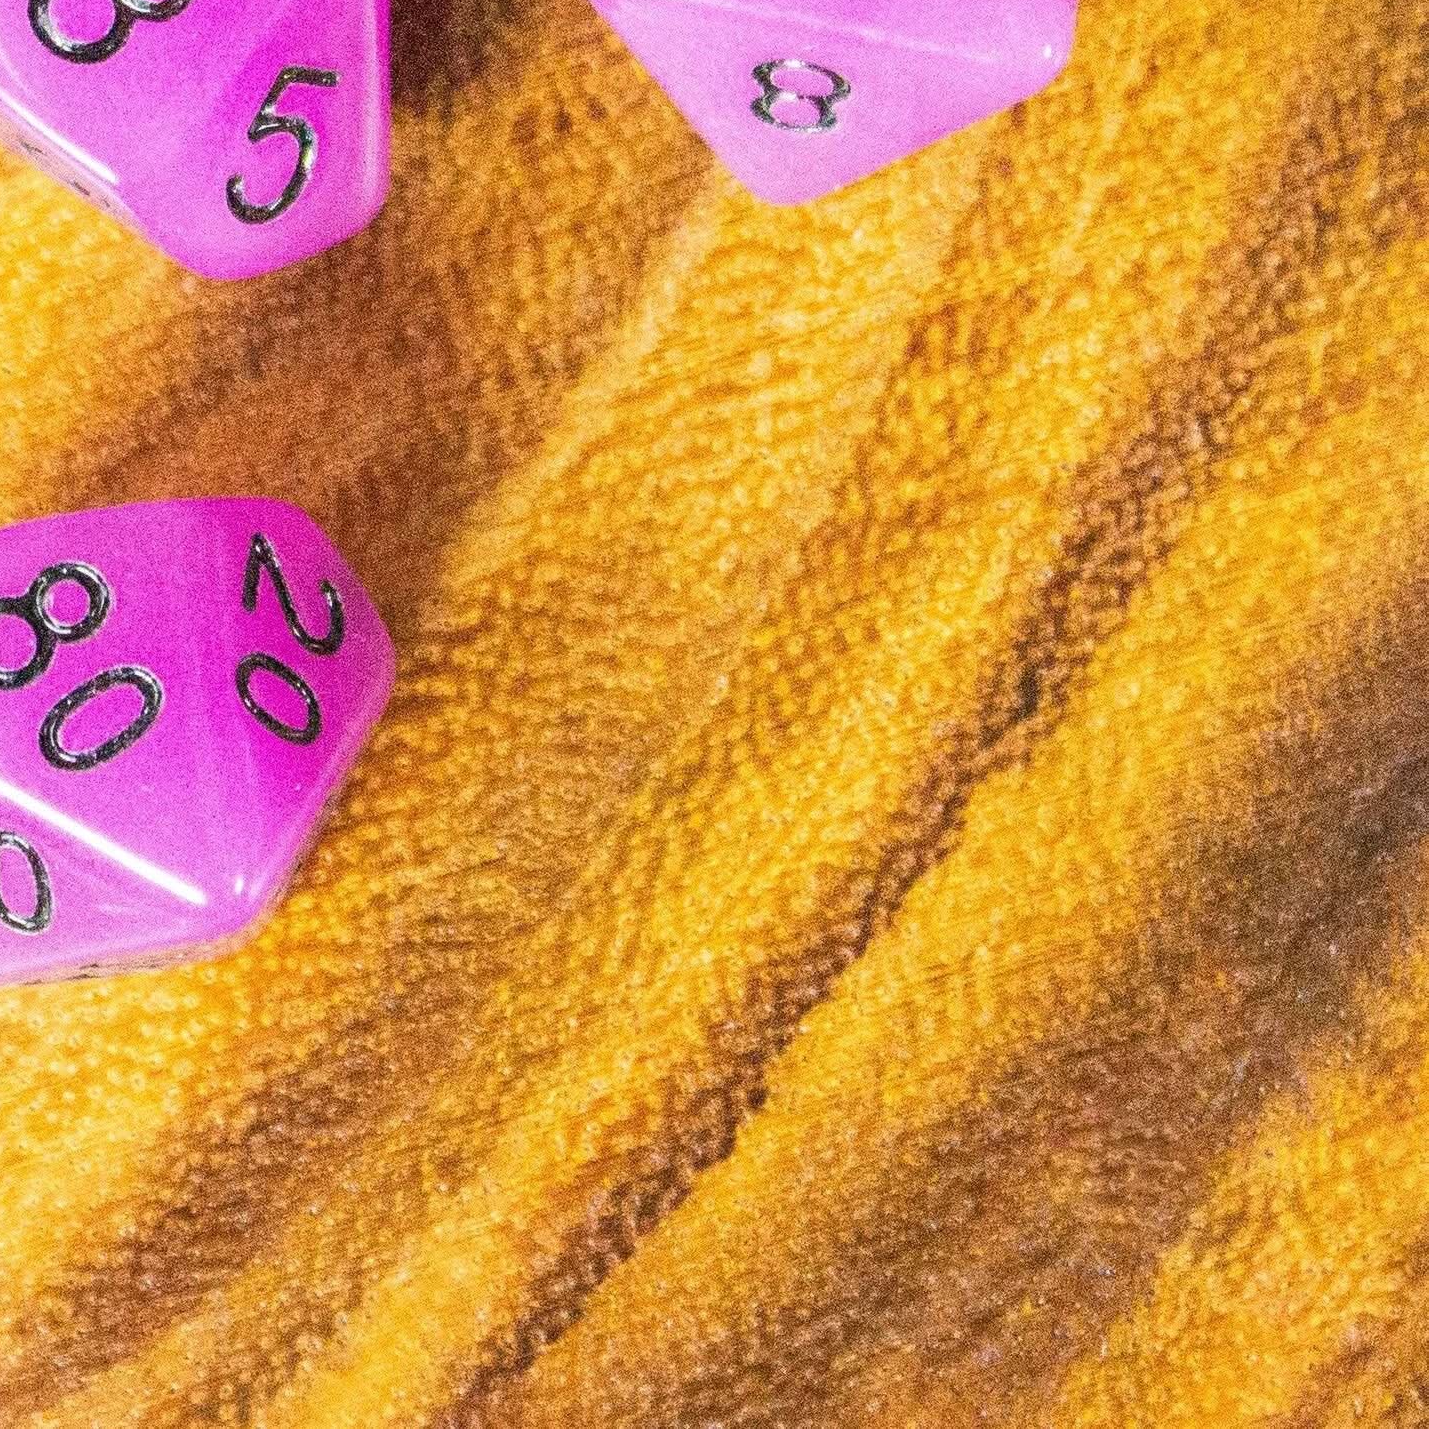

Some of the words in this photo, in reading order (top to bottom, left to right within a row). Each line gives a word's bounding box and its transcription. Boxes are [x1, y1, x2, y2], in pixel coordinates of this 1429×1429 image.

[225, 64, 341, 225] 5
[749, 57, 852, 133] 8
[235, 532, 346, 747] 20
